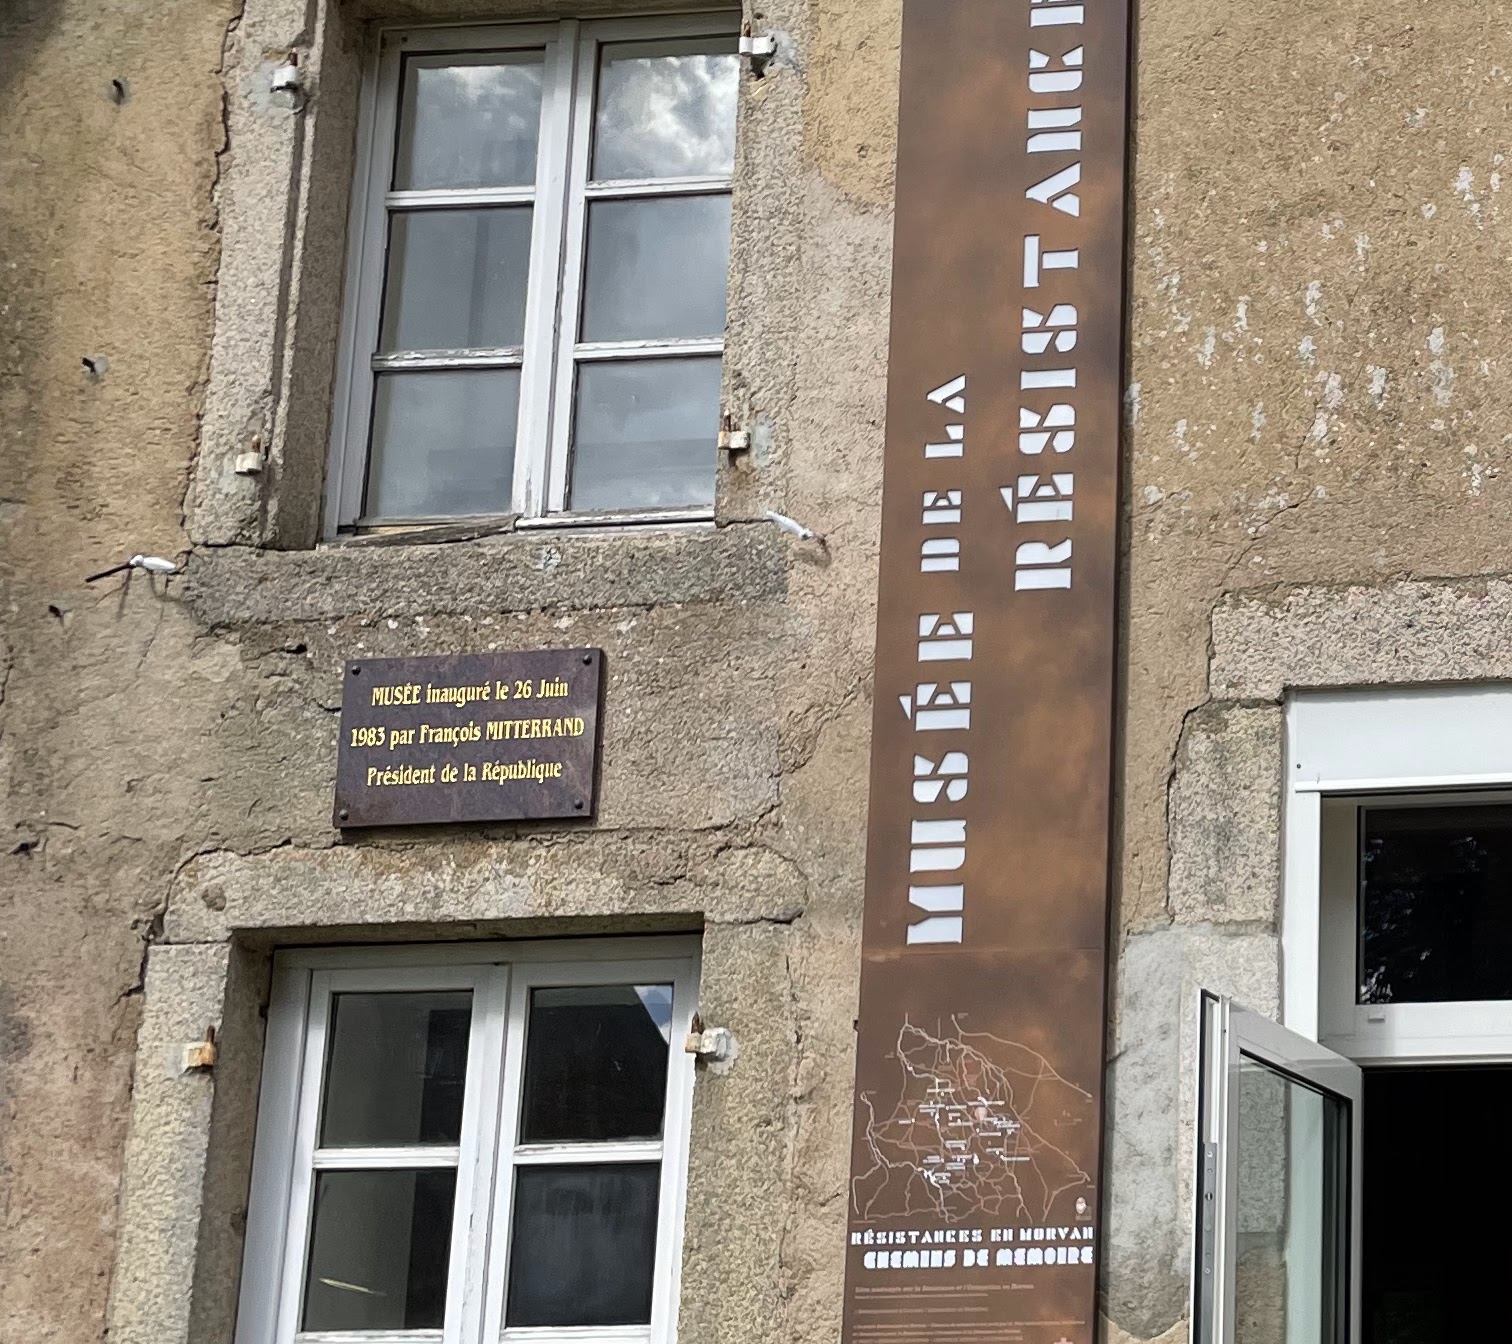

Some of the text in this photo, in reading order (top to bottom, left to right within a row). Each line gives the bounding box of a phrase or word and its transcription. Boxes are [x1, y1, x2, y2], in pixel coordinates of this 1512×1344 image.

[898, 372, 975, 945] MUSÉE DE LA
[371, 676, 569, 708] MUSÉE inauguré le 26 Juin
[389, 728, 416, 750] par
[419, 721, 482, 747] François
[486, 717, 585, 741] MITTERRAND
[367, 759, 563, 786] Président de la République
[851, 1226, 1094, 1246] RÉSISTANCES EN MORVAN
[963, 1248, 989, 1267] DE
